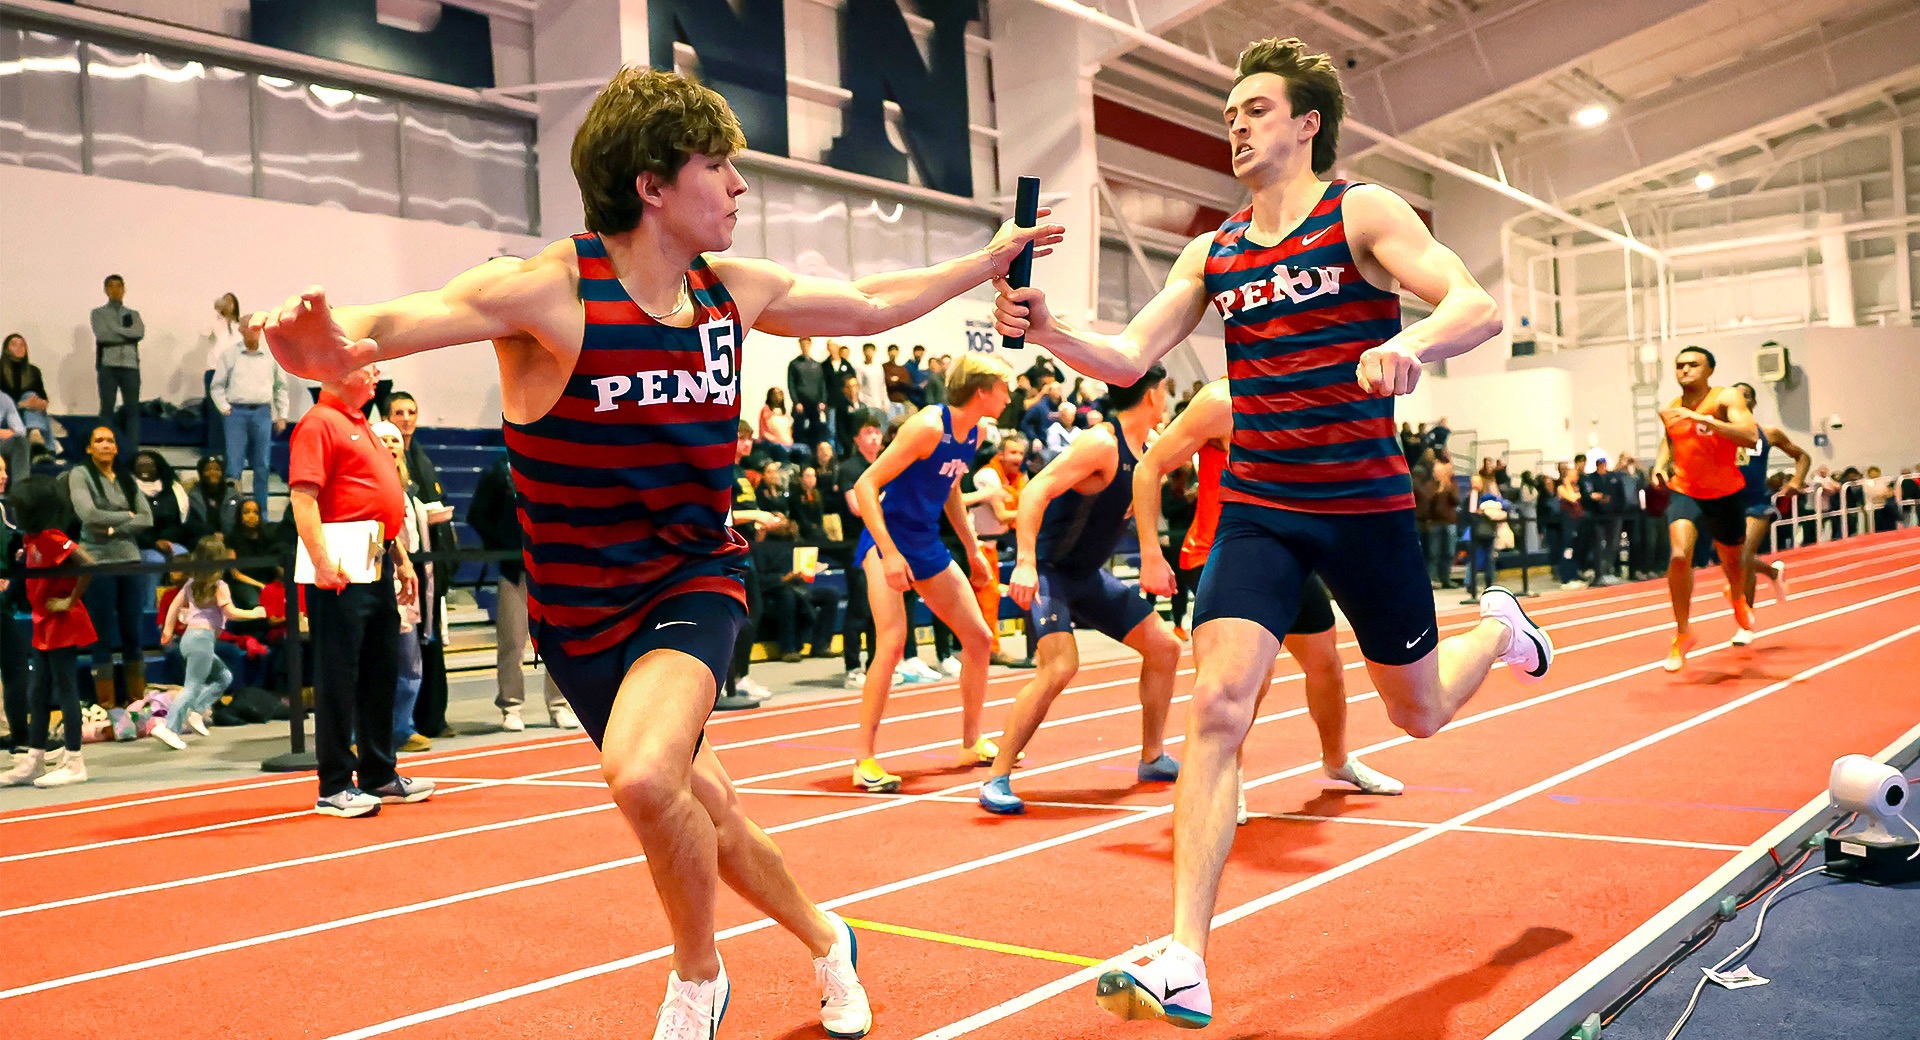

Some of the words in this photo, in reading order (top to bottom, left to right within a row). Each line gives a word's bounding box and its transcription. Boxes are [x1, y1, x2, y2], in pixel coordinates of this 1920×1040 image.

[708, 325, 734, 387] 5
[966, 331, 994, 353] 105
[591, 370, 738, 412] PEN
